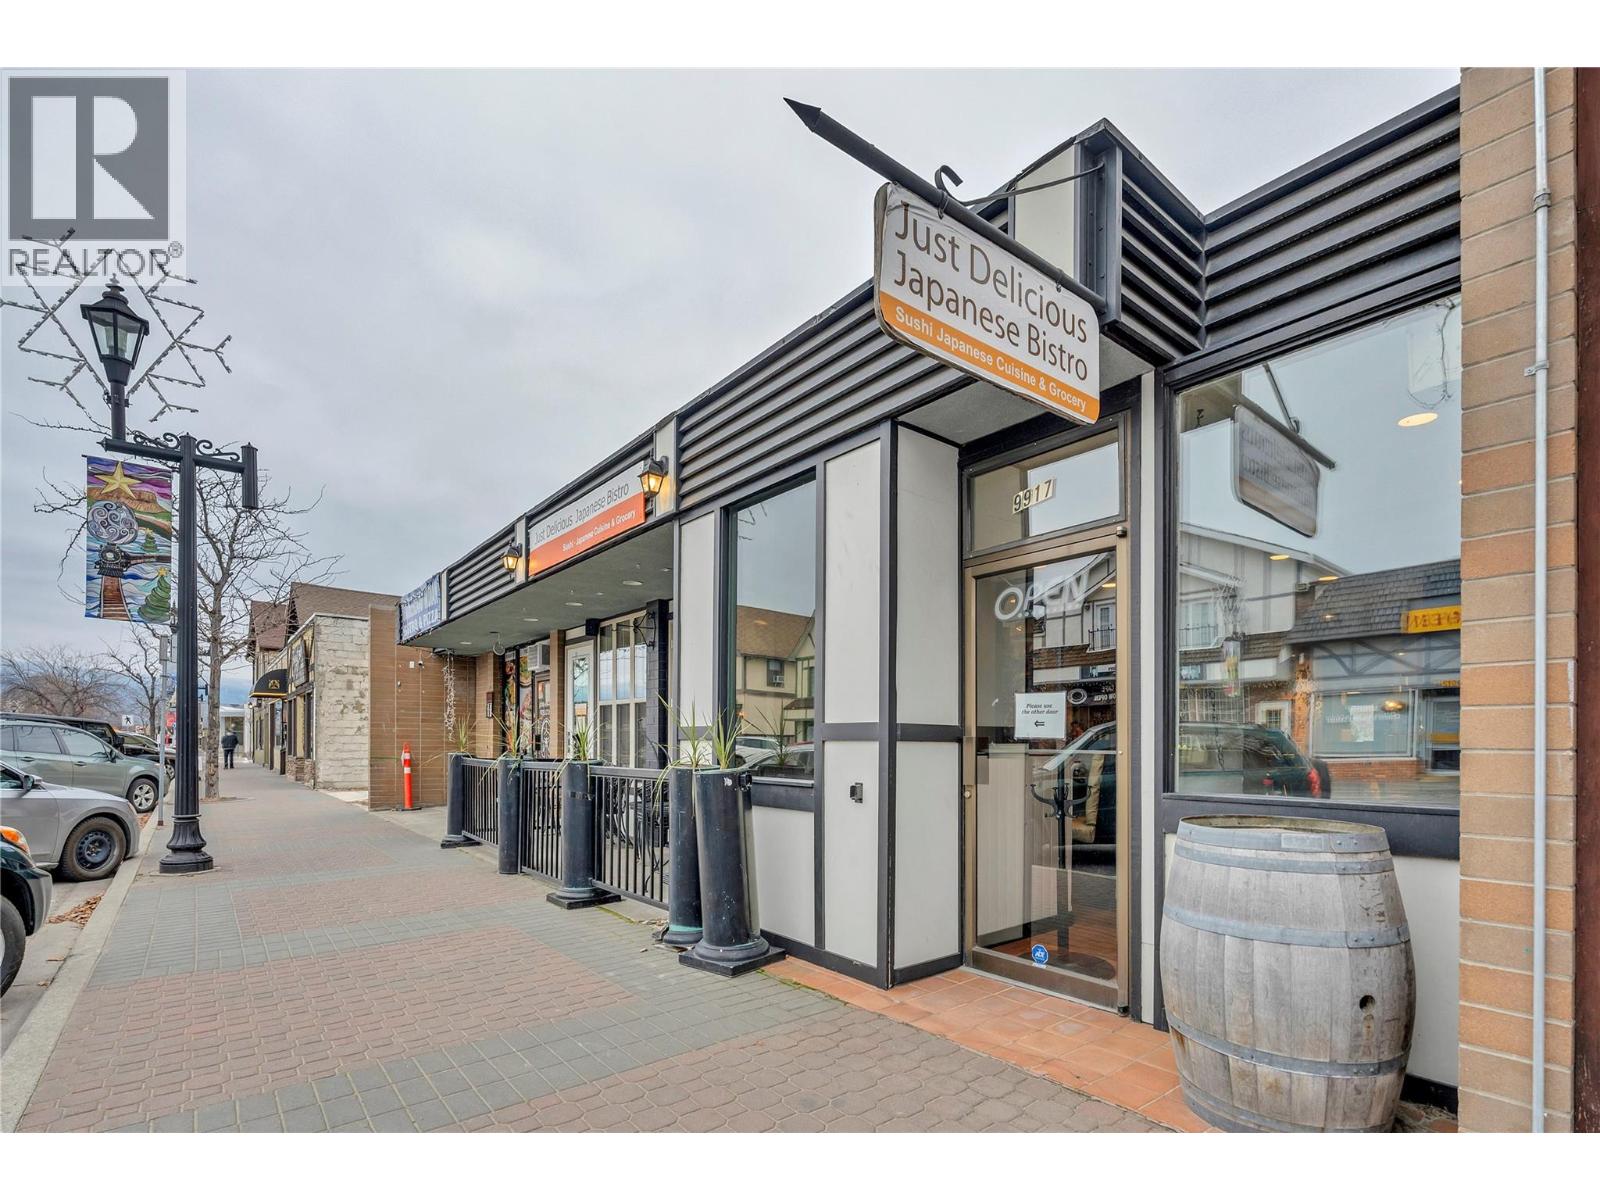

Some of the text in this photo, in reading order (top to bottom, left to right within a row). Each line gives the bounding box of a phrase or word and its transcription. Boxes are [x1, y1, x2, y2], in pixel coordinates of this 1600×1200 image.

[894, 250, 1088, 381] Japanese Bistro
[895, 200, 1087, 343] Just Delicious
[895, 306, 1087, 412] Sushi Japanese Cuisine & Grocery
[535, 483, 629, 545] Just Delicious Japanese Bistro
[1013, 480, 1052, 512] 9917
